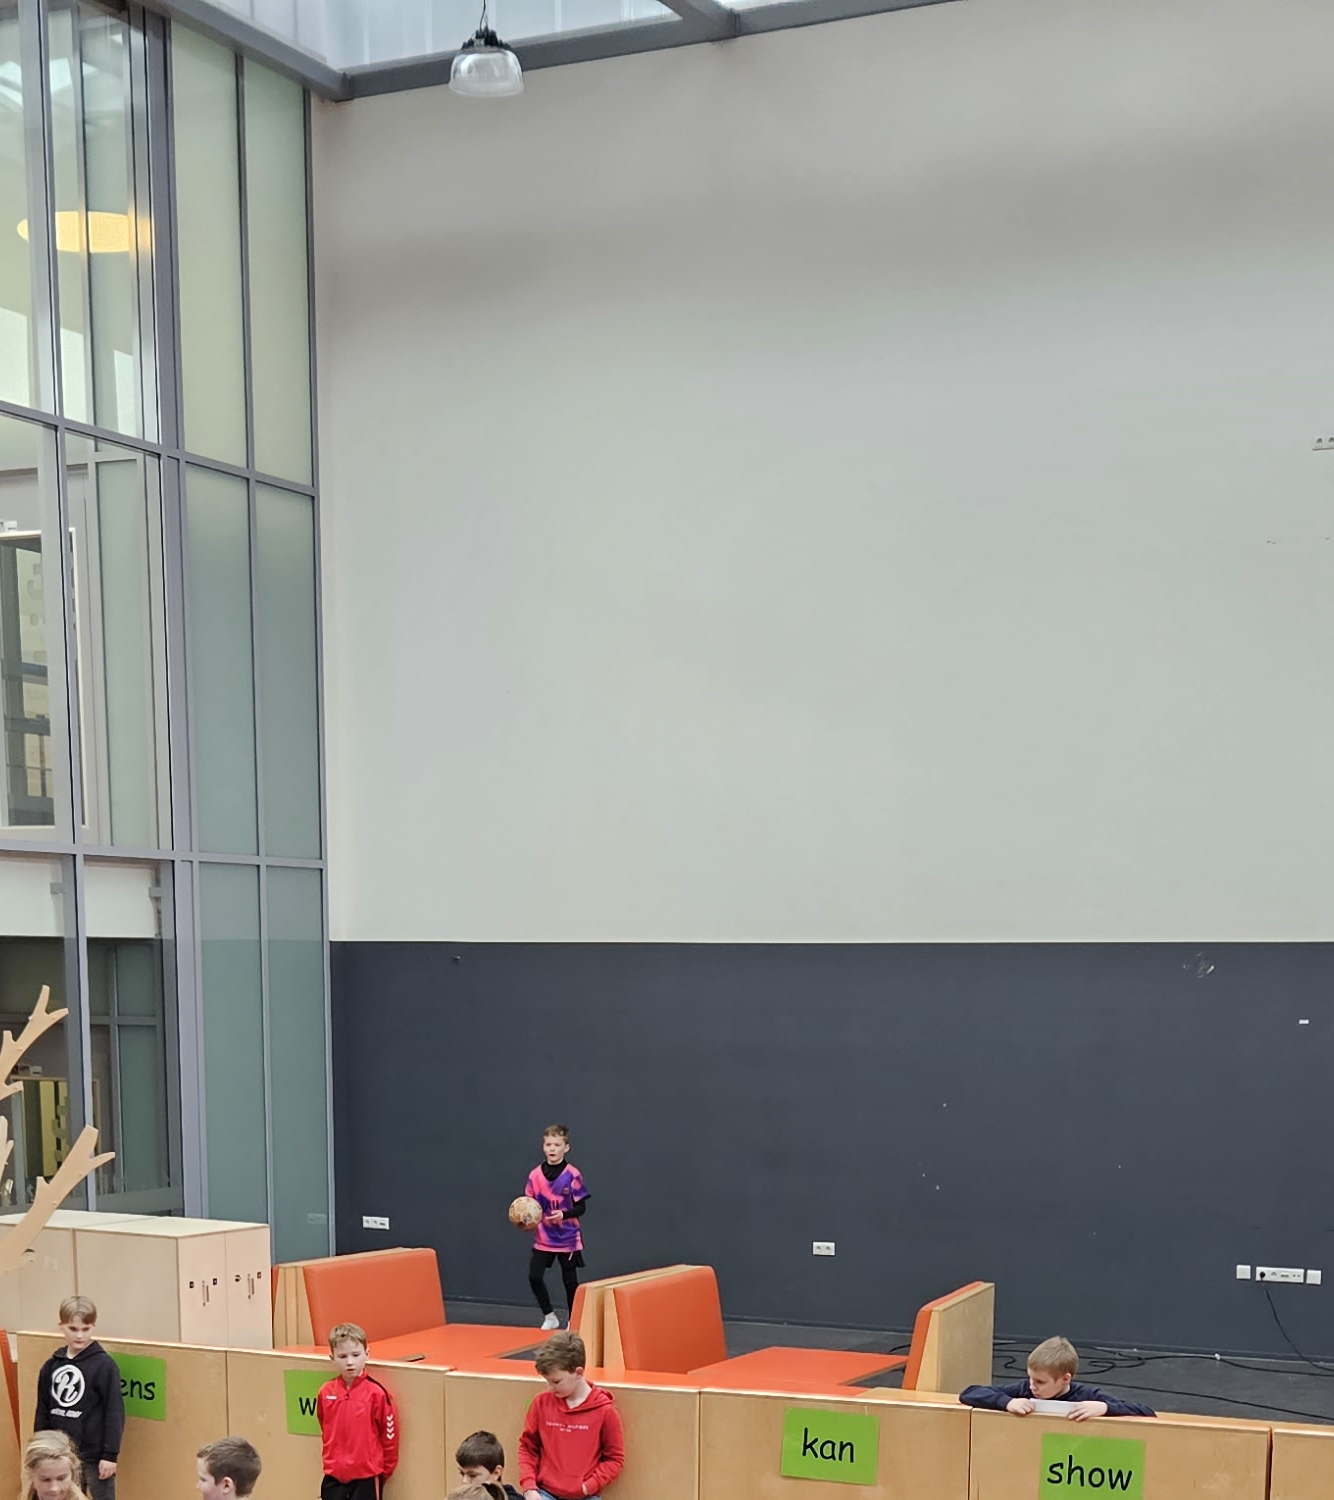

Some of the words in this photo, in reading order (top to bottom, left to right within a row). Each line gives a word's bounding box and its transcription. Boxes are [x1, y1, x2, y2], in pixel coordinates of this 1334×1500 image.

[120, 1379, 156, 1401] ens
[801, 1426, 855, 1463] kan
[1046, 1454, 1133, 1491] show
